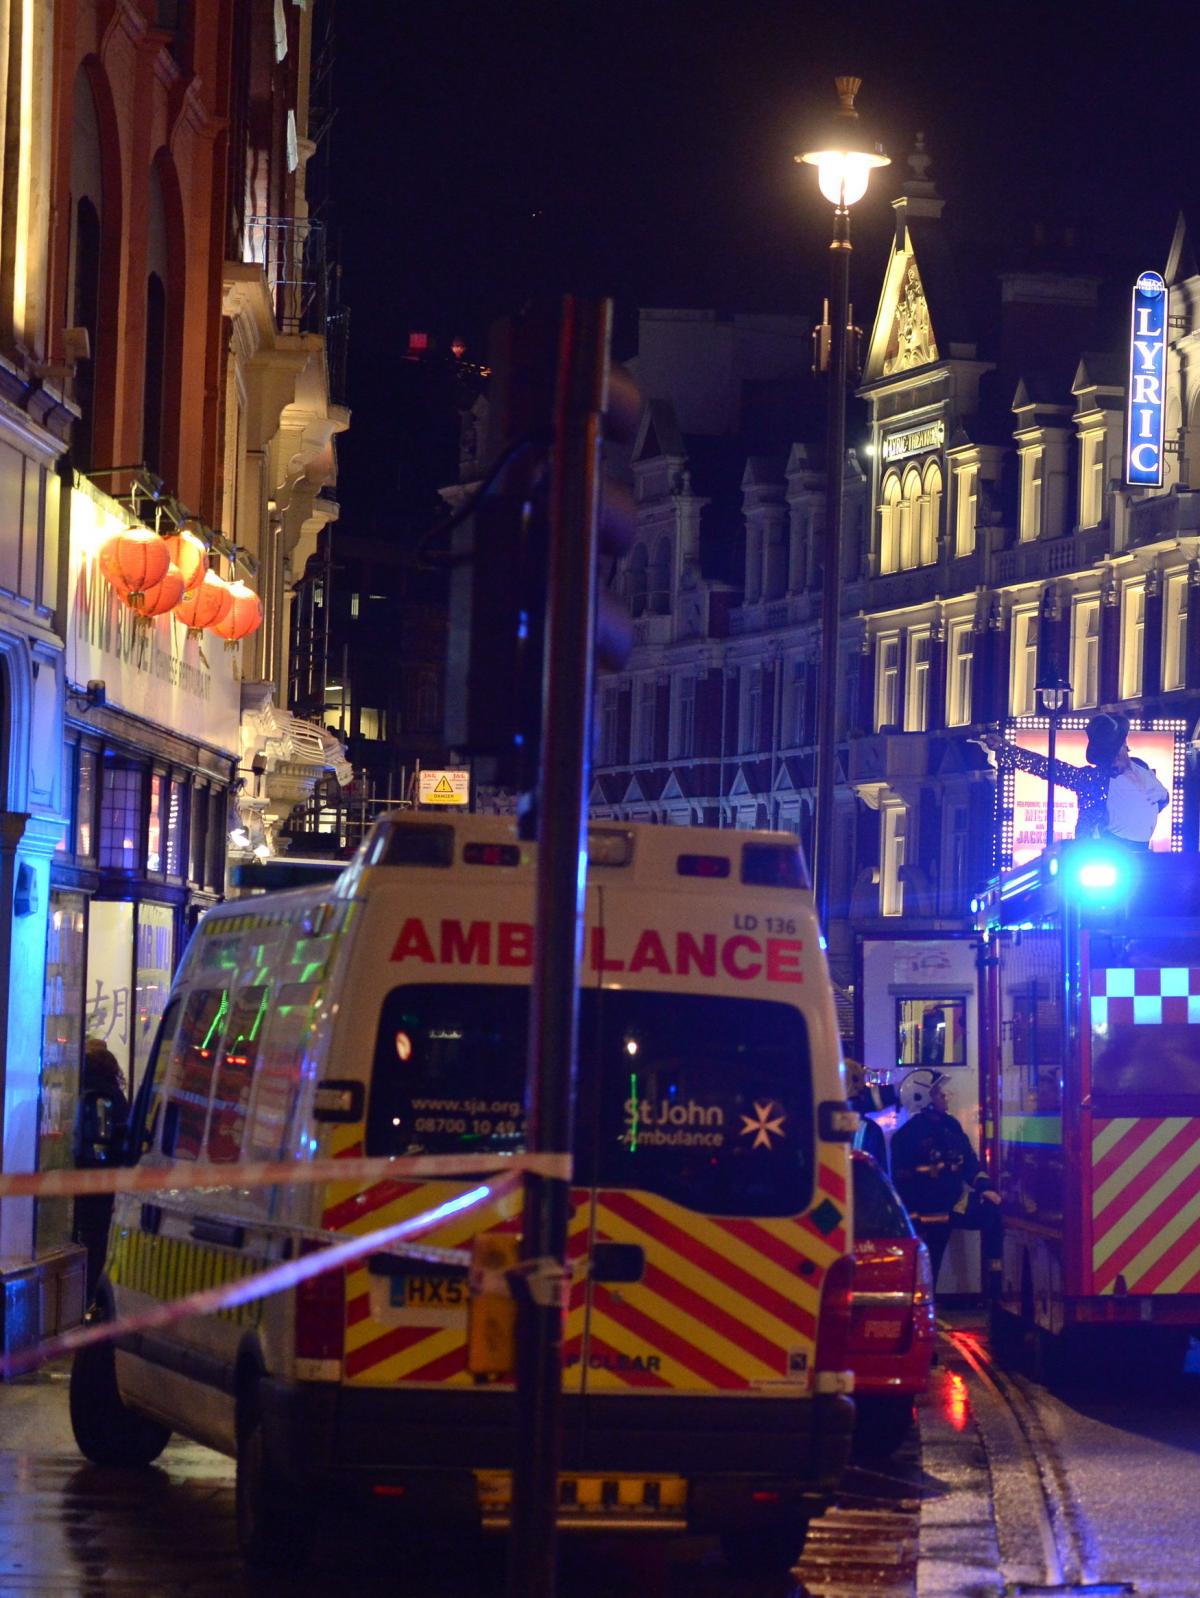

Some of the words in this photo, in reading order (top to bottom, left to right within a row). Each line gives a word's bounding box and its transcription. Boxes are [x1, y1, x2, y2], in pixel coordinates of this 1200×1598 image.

[1131, 307, 1163, 472] LYRIC
[734, 913, 759, 930] LD
[765, 917, 797, 935] 136
[388, 917, 805, 984] AMBLANCE
[624, 1099, 652, 1125] St
[657, 1099, 724, 1126] John
[415, 1117, 466, 1133] 08700
[472, 1119, 492, 1135] 10
[623, 1130, 724, 1147] Ambulance
[409, 1279, 465, 1303] HX5
[590, 1354, 661, 1372] CLEAR
